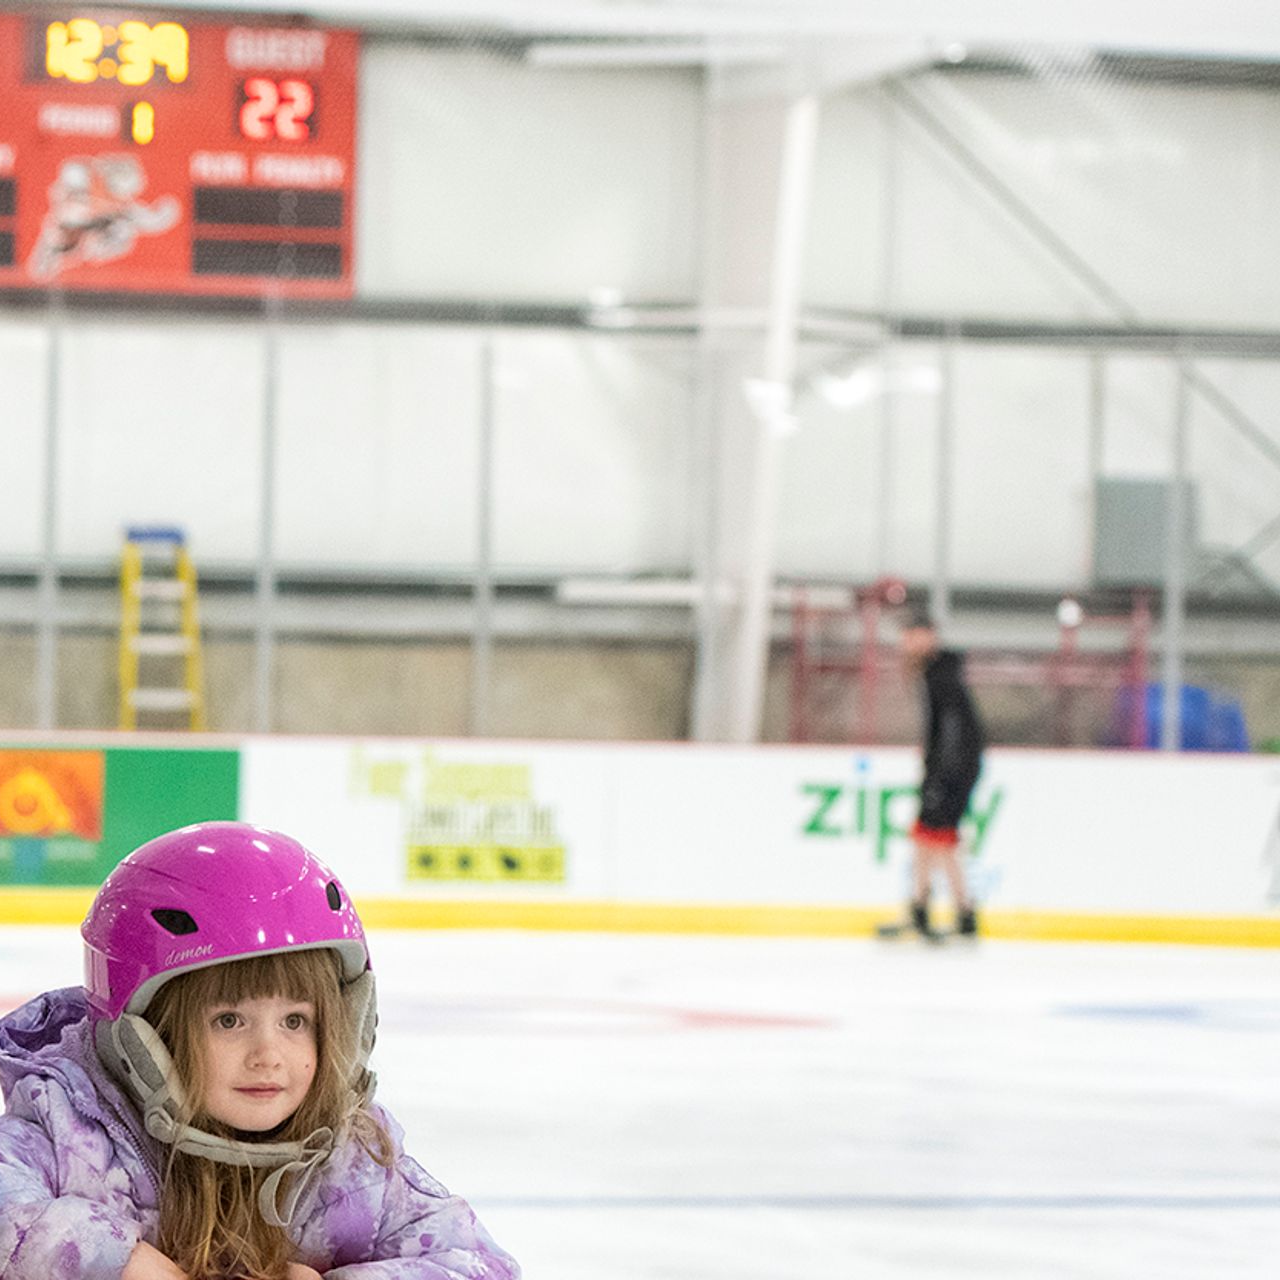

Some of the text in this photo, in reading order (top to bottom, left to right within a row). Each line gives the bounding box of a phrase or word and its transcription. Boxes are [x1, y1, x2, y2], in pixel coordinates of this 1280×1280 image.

[46, 17, 190, 85] 12:39
[226, 28, 327, 71] GUEST
[131, 101, 155, 145] 1
[241, 77, 316, 142] 22
[801, 758, 1006, 862] zipy
[164, 943, 214, 967] demon
